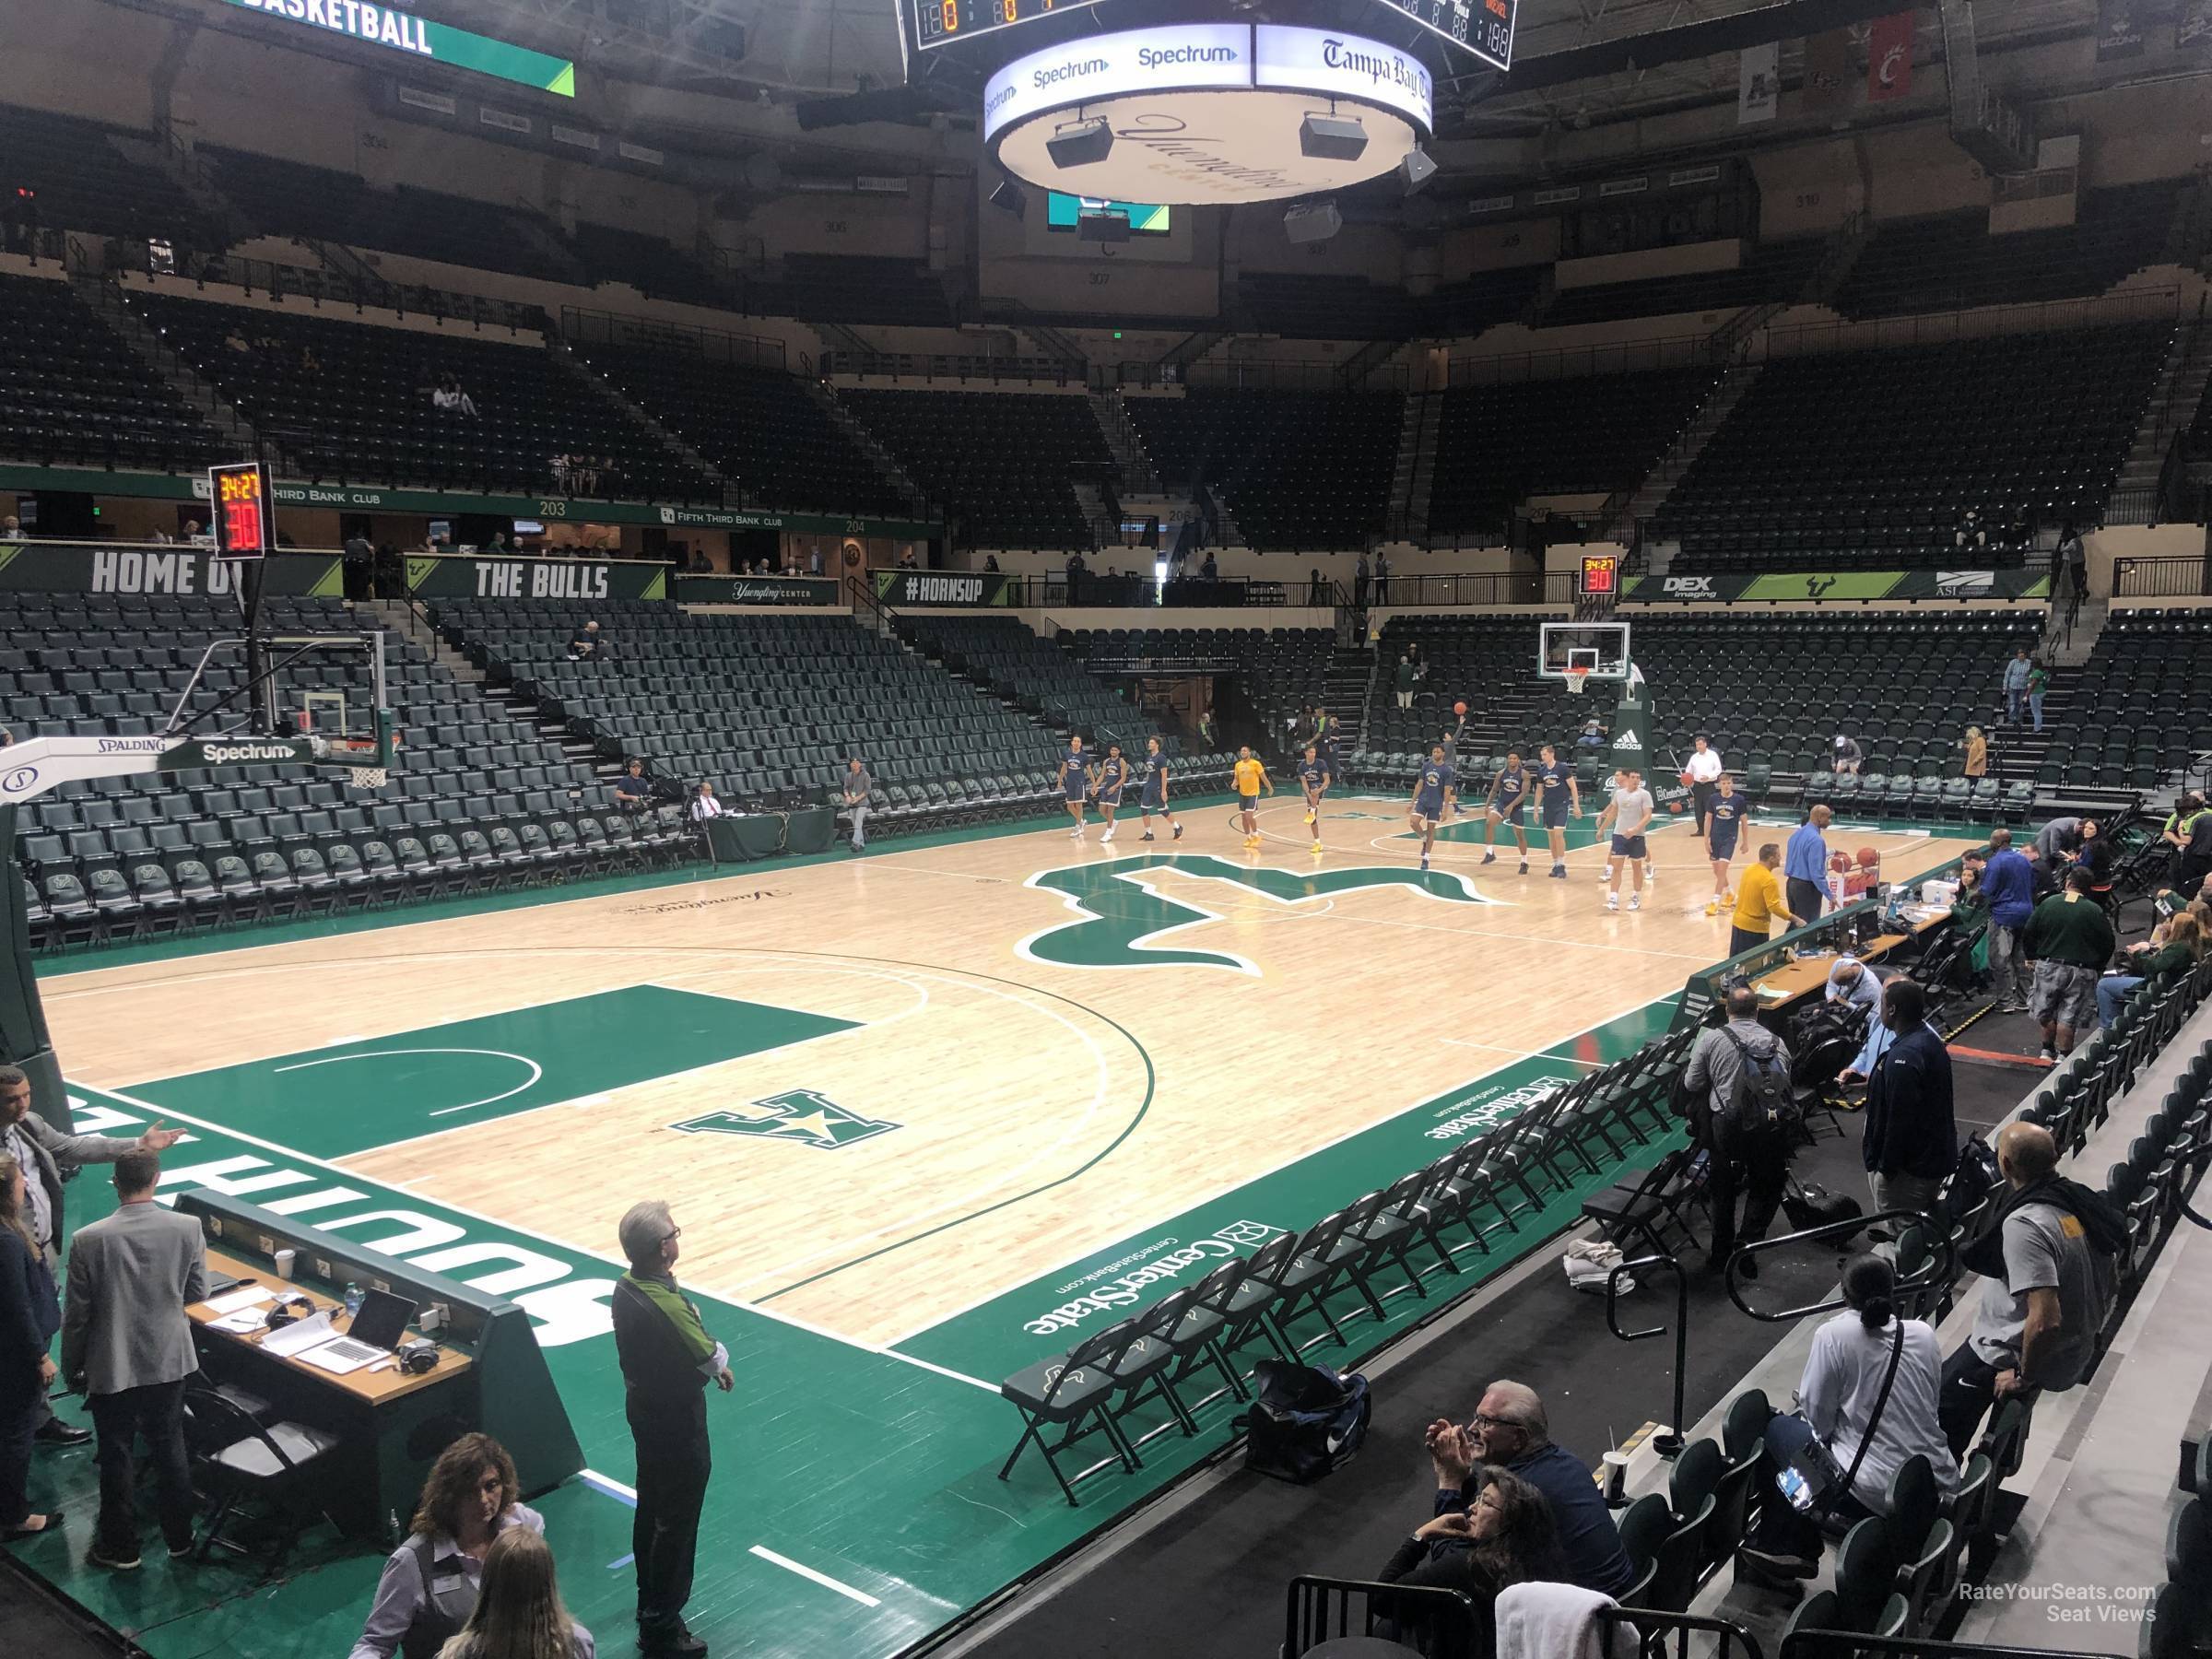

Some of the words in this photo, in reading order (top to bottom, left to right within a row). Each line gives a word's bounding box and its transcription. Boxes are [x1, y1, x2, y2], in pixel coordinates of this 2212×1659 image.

[243, 0, 432, 54] SKETBALL
[1138, 45, 1231, 69] Spectrum
[1033, 58, 1104, 90] Spectrum
[1322, 39, 1391, 85] Tampa
[1394, 55, 1418, 98] Bay
[985, 85, 1015, 119] Spectrum
[220, 474, 260, 501] 34:27
[273, 489, 306, 500] HIRD
[310, 490, 346, 503] BANK
[352, 494, 381, 504] CLUB
[539, 501, 566, 517] 203
[677, 512, 704, 523] FIFTH
[705, 513, 734, 524] THIRD
[735, 515, 759, 526] BANK
[763, 517, 782, 527] CLUB
[846, 520, 865, 534] 204
[92, 551, 196, 594] HOME
[1585, 559, 1614, 571] 34:27
[476, 562, 524, 597] THE
[532, 564, 608, 599] BULLS
[1588, 571, 1611, 591] 30
[1663, 576, 1713, 592] DEX
[732, 582, 782, 601] Yuengling
[781, 590, 811, 598] CENTER
[1674, 590, 1717, 599] imaging
[1936, 586, 1956, 596] ASI
[98, 738, 167, 753] SPALDING
[203, 743, 289, 764] Spectrum
[1612, 741, 1642, 750] adidas
[1054, 1237, 1179, 1294] CenterStateBank.com
[1023, 1240, 1235, 1335] CenterState
